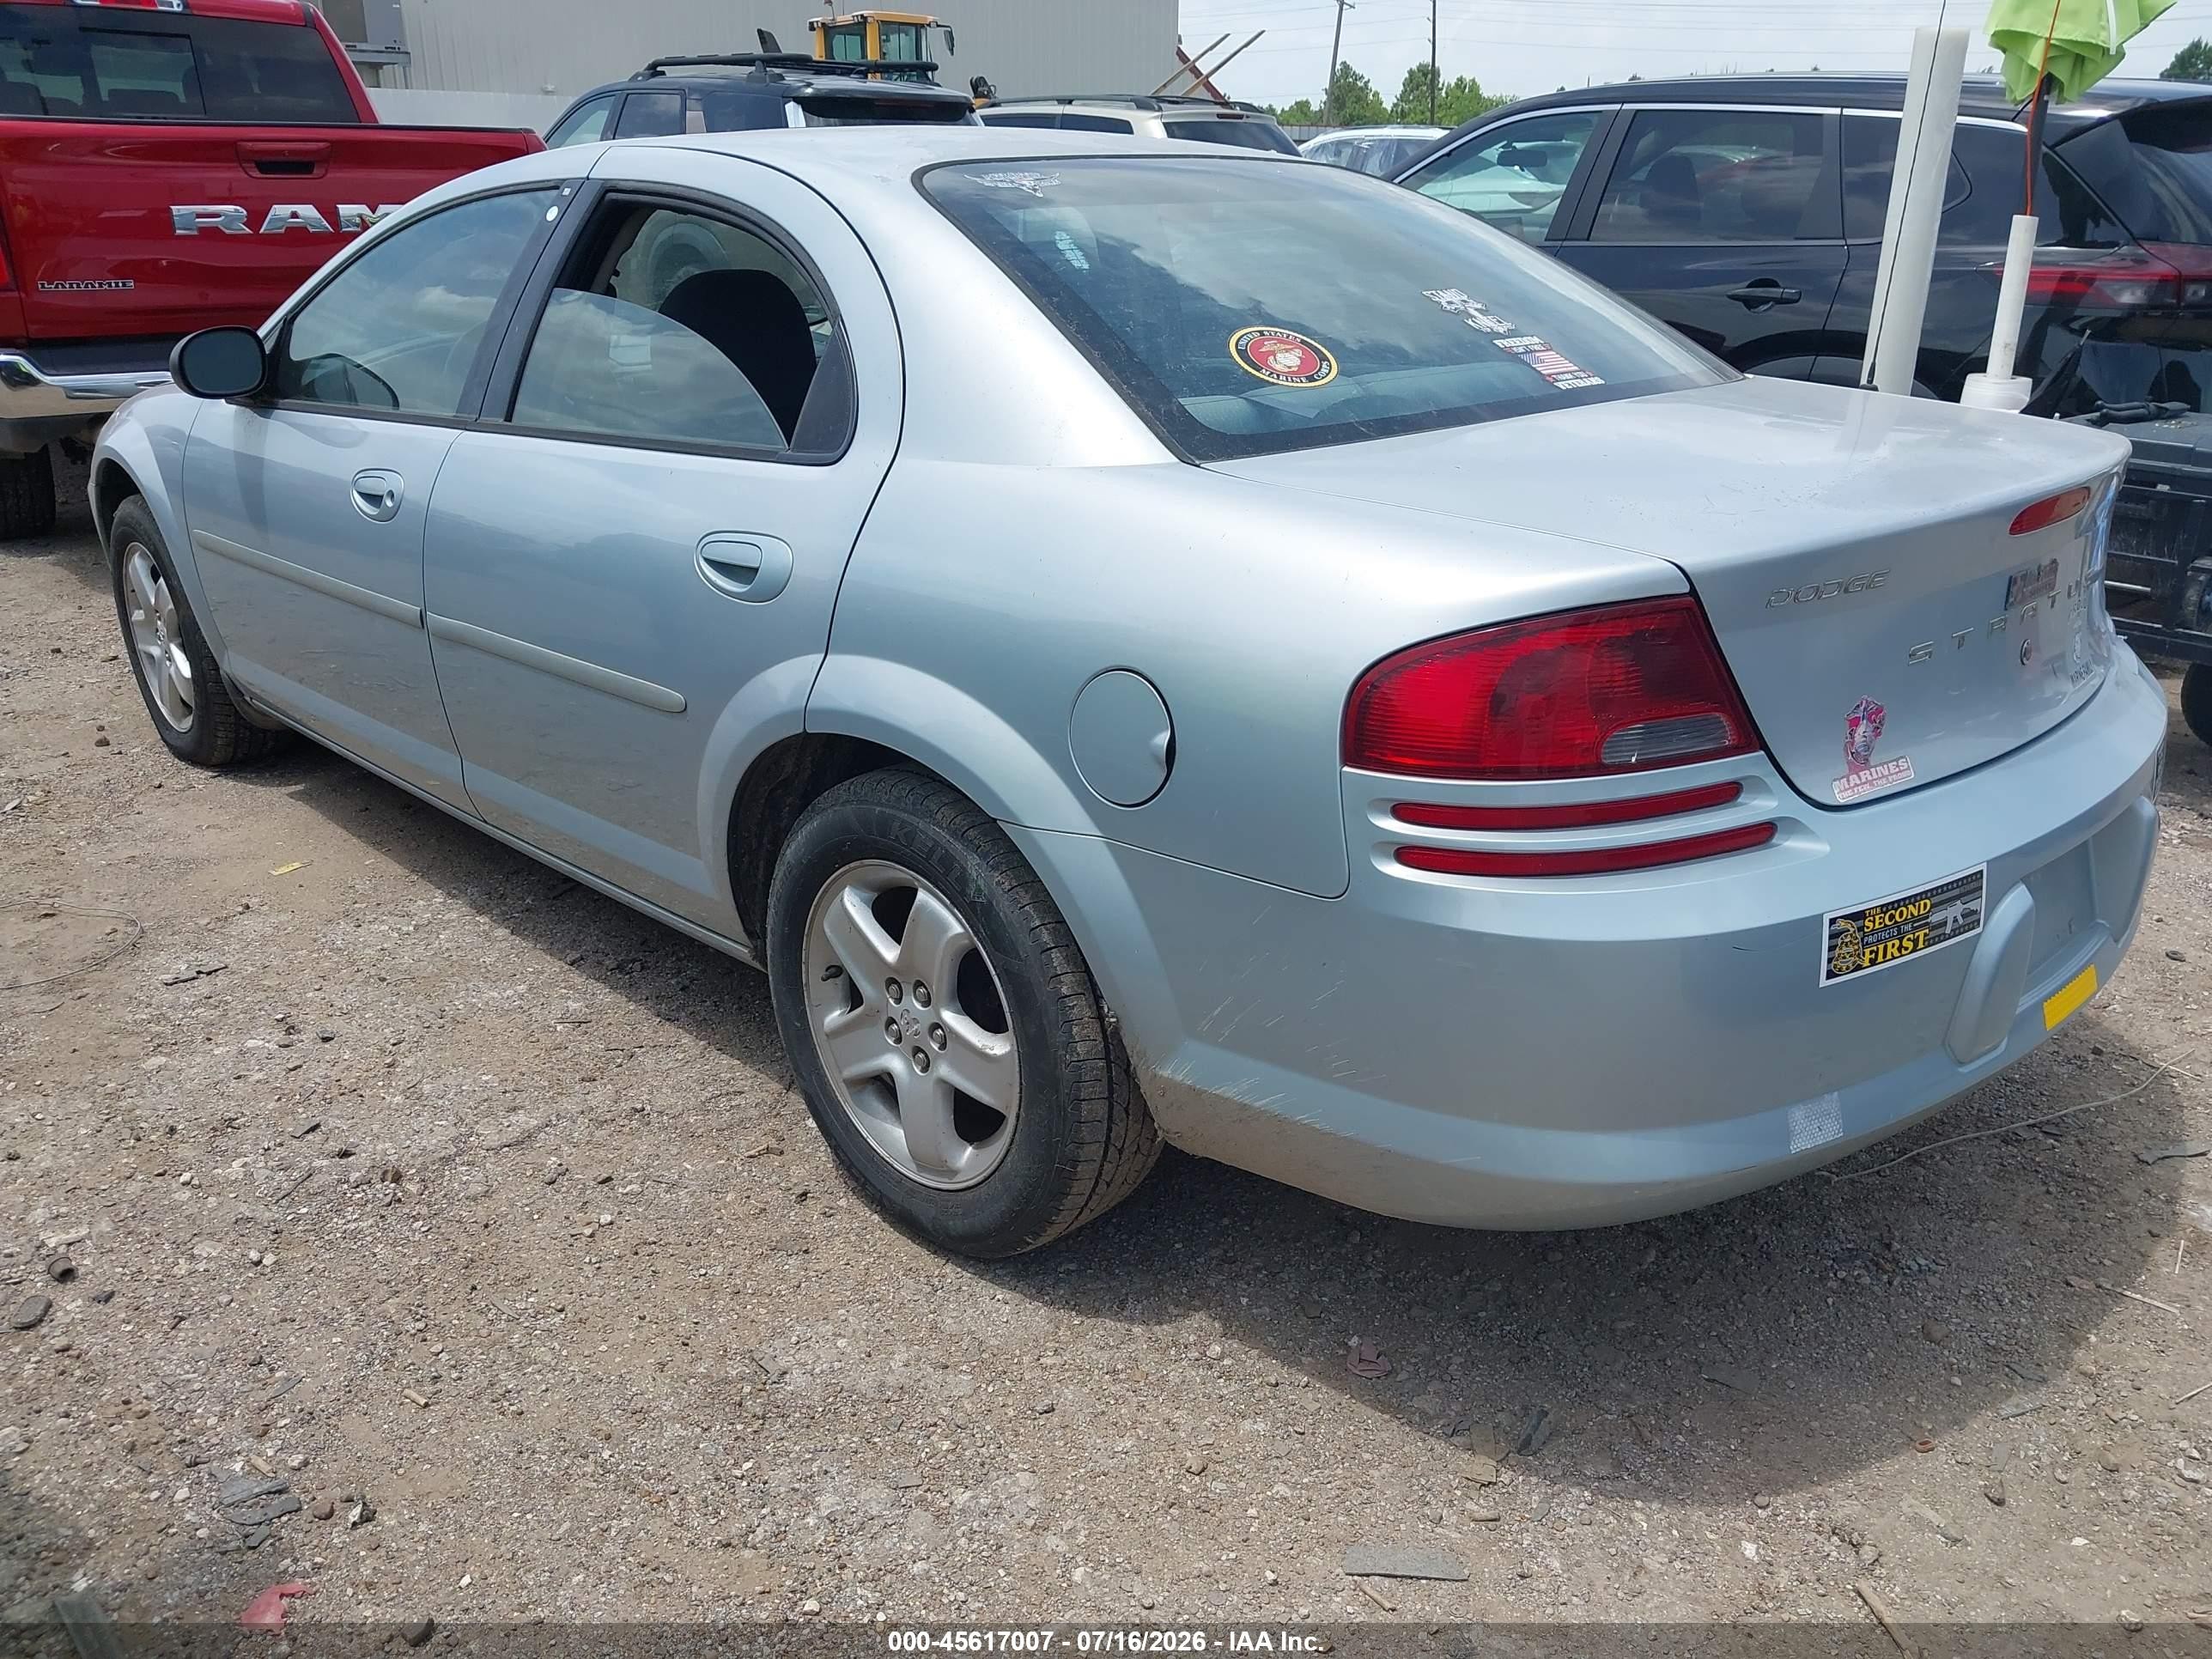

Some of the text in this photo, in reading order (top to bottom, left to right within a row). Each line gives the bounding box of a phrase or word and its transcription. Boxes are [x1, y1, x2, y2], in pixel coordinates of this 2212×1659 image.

[169, 204, 405, 234] RAM
[38, 280, 134, 290] LARAMIE
[1238, 331, 1301, 350] UNITED STATES
[1260, 361, 1330, 383] MARINE CORPS
[1553, 376, 1606, 390] VETERANS
[1765, 569, 1890, 609] DODGE
[1834, 758, 1909, 793] MARINES
[1838, 791, 1854, 799] THE
[1864, 906, 1881, 917] THE
[1864, 899, 1932, 932] SECOND
[1863, 922, 1913, 945] PROTECTS THE
[1863, 928, 1929, 967] FIRST
